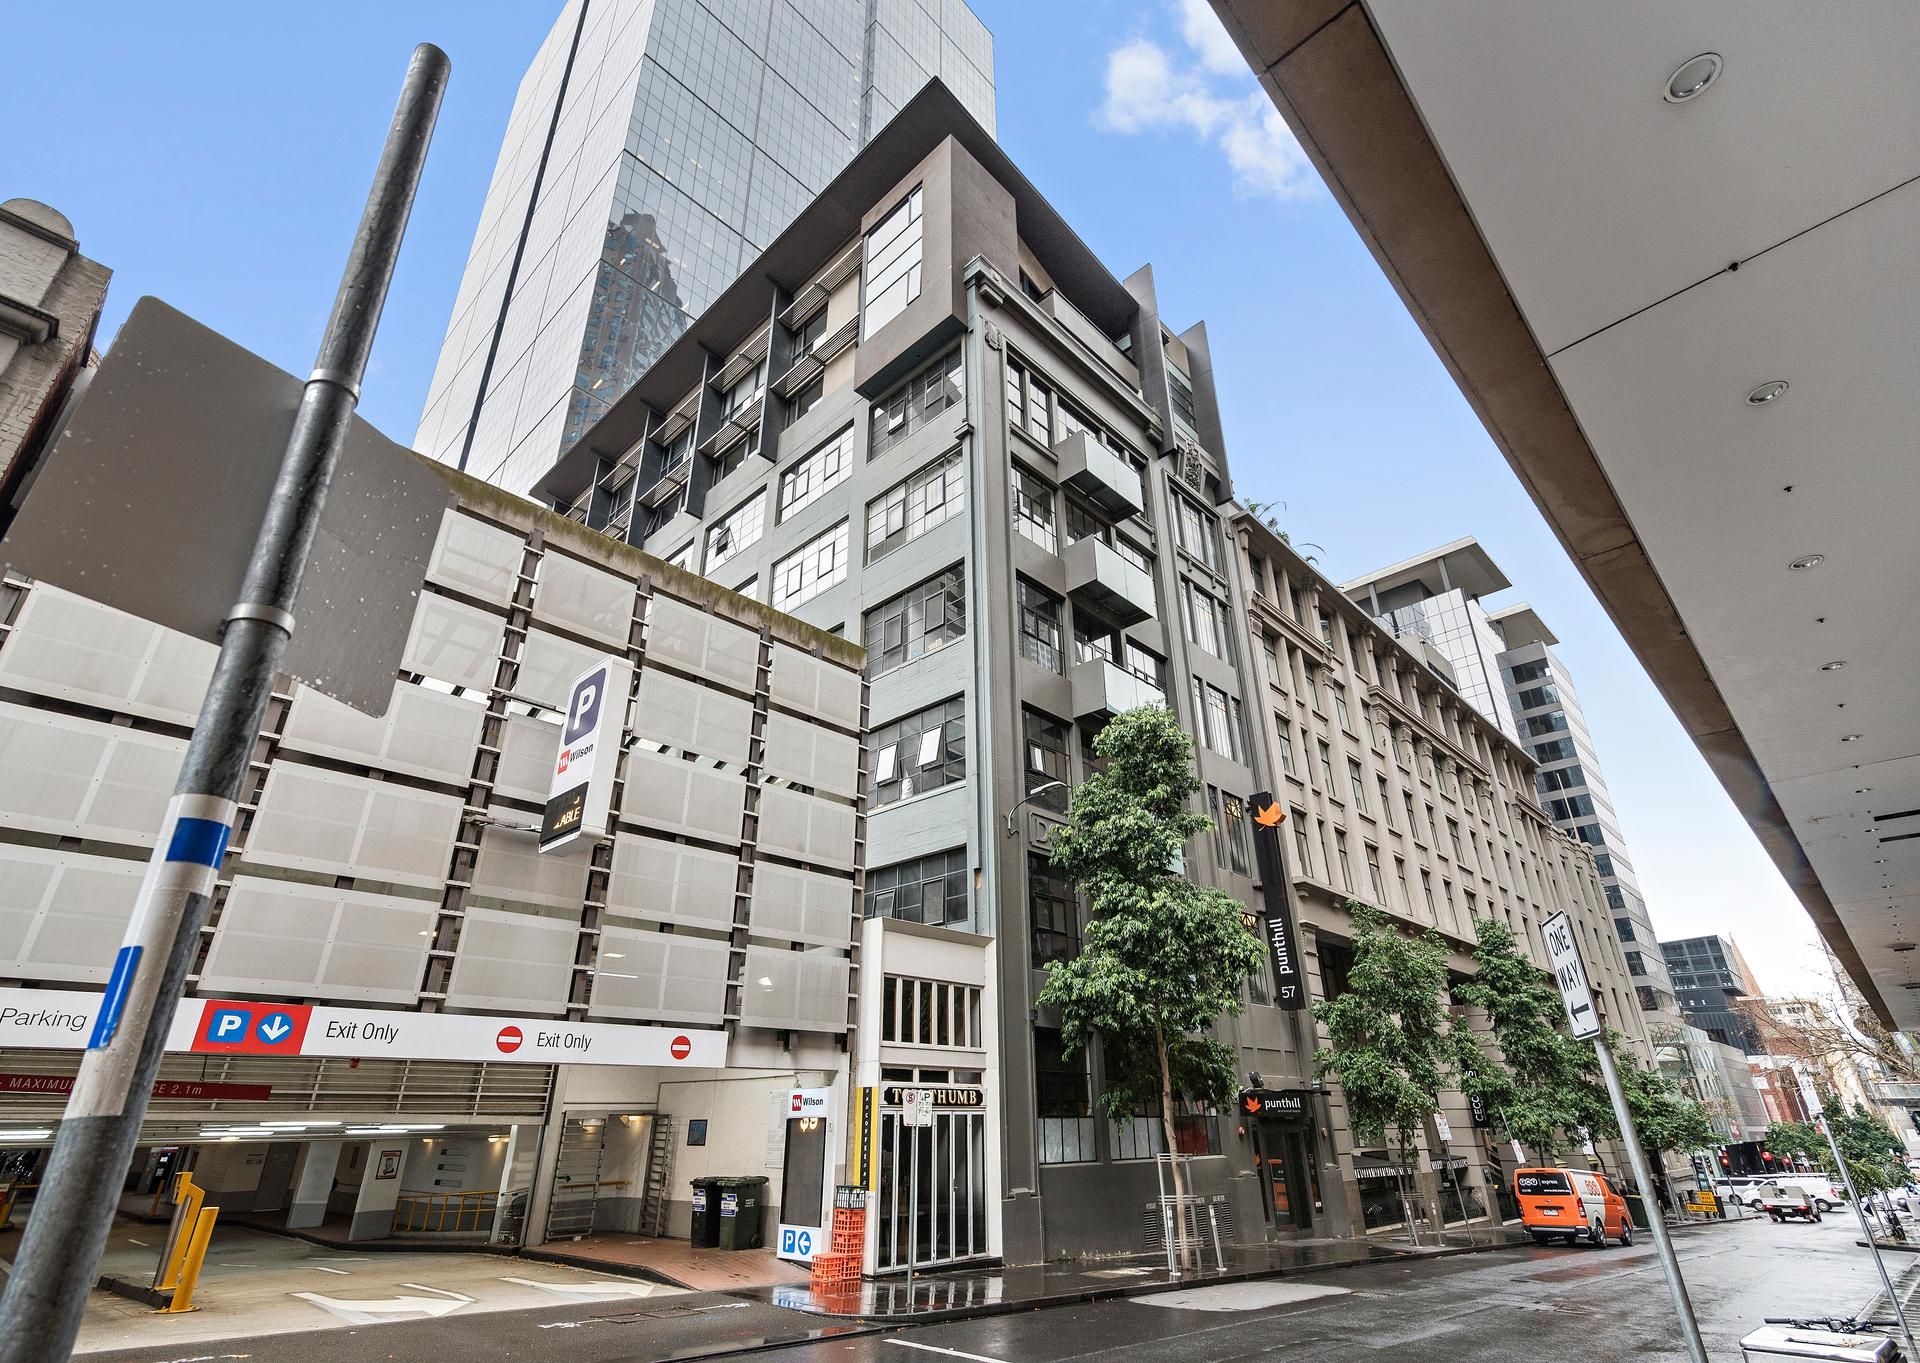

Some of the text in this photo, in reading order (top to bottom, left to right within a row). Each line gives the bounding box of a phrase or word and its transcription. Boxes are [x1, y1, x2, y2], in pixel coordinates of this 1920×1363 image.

[573, 684, 597, 731] P
[570, 743, 594, 762] Wilson
[1268, 918, 1294, 975] punthill
[1549, 924, 1571, 957] ONE
[1557, 959, 1582, 993] WAY
[1281, 985, 1296, 999] 57
[0, 1007, 88, 1032] Parking
[217, 1014, 242, 1037] P
[325, 1020, 400, 1044] Exit Only
[536, 1031, 592, 1052] Exit Only
[9, 1077, 77, 1090] MAXIMU
[171, 1084, 202, 1095] 2.1m
[802, 1097, 824, 1107] Wilson
[1265, 1098, 1301, 1110] punthill
[786, 1232, 794, 1250] P
